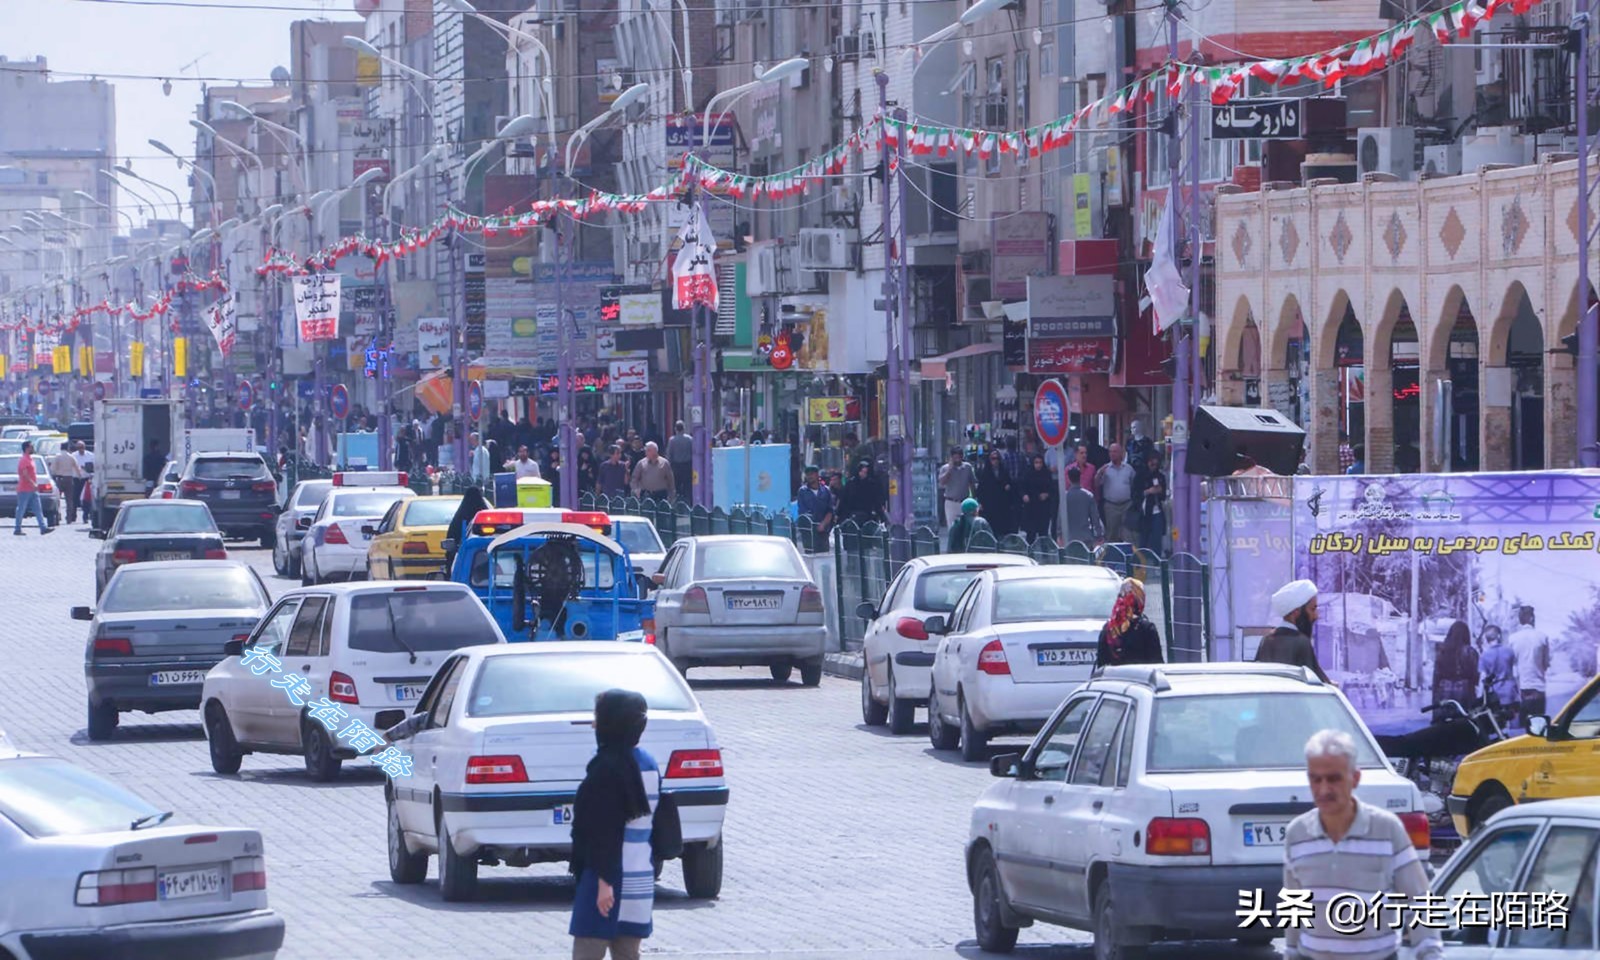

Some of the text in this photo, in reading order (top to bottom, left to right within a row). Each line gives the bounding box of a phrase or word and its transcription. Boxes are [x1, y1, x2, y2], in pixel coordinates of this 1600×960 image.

[1215, 104, 1296, 135] داروخانه
[612, 366, 645, 380] پیکسل
[113, 440, 135, 454] دارو
[1310, 531, 1596, 555] کمک های مردمی به سیل زدگان
